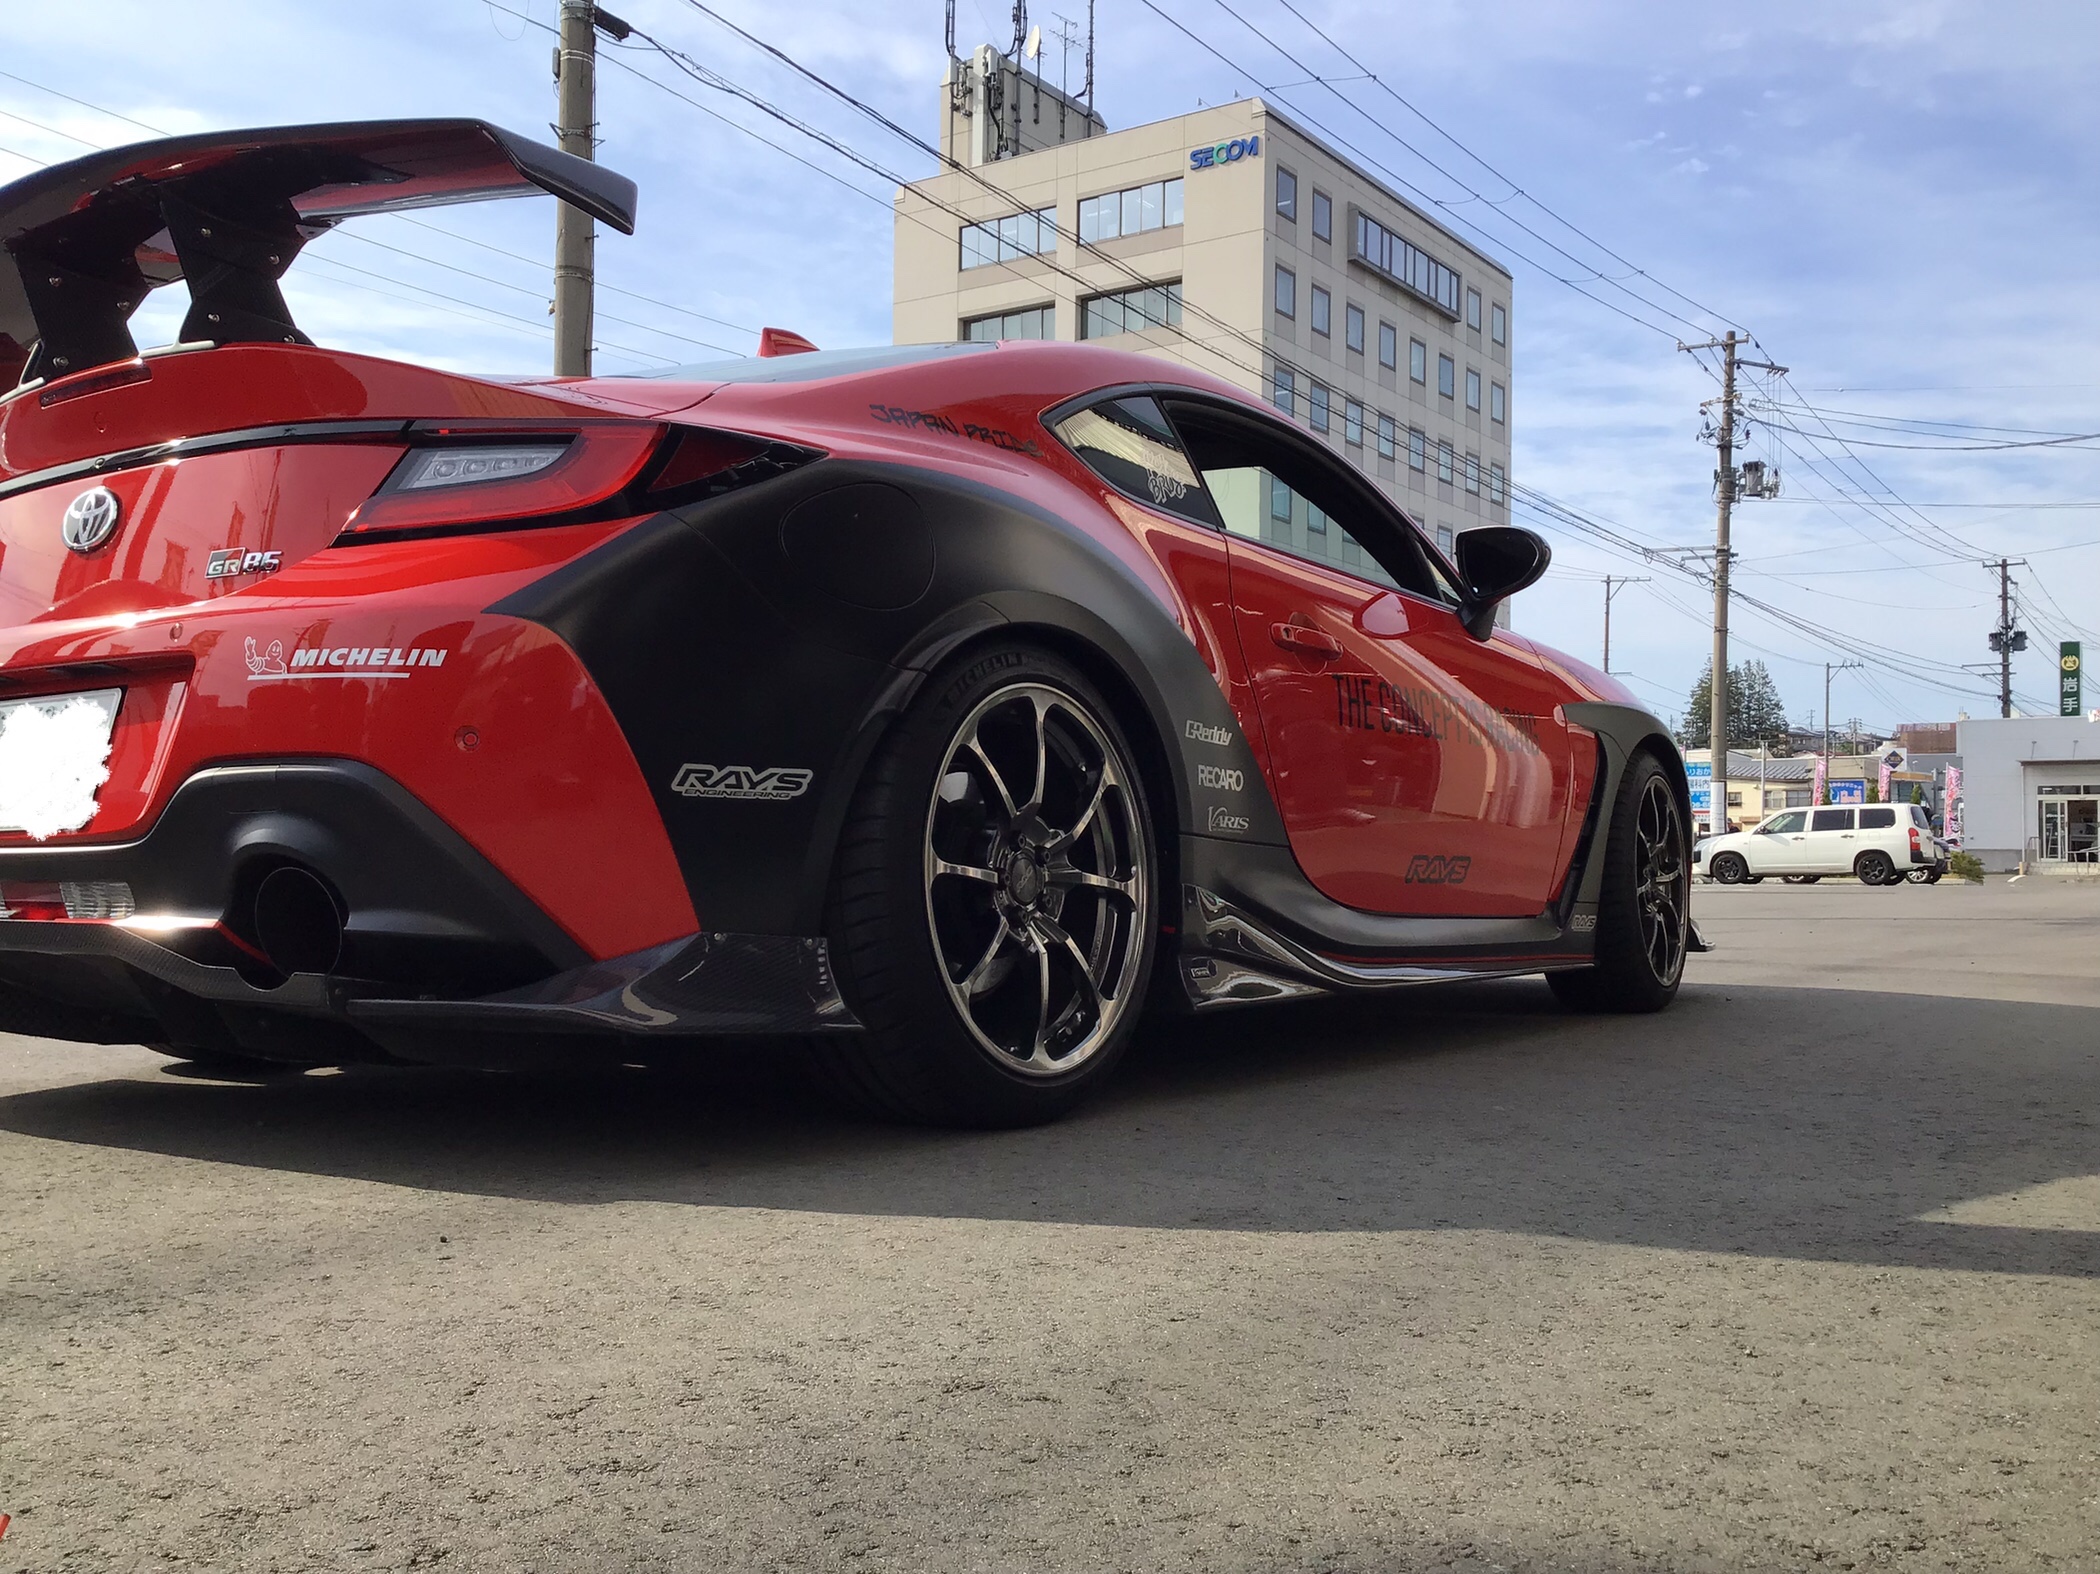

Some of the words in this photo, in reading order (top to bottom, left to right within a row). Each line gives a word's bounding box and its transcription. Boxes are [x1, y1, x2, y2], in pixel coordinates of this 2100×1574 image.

[1190, 136, 1259, 170] SECOM
[869, 404, 960, 438] JAPAN
[963, 422, 1045, 458] PRIDE
[289, 647, 449, 668] MICHELIN
[1332, 674, 1375, 731] THE
[1379, 681, 1462, 743] CONCEPT
[2062, 676, 2079, 713] 岩手
[1185, 719, 1233, 746] GReddy
[673, 765, 812, 792] RAYS
[1197, 764, 1244, 792] RECARO
[683, 787, 792, 800] ENGINEERING
[1405, 855, 1470, 883] RAYS
